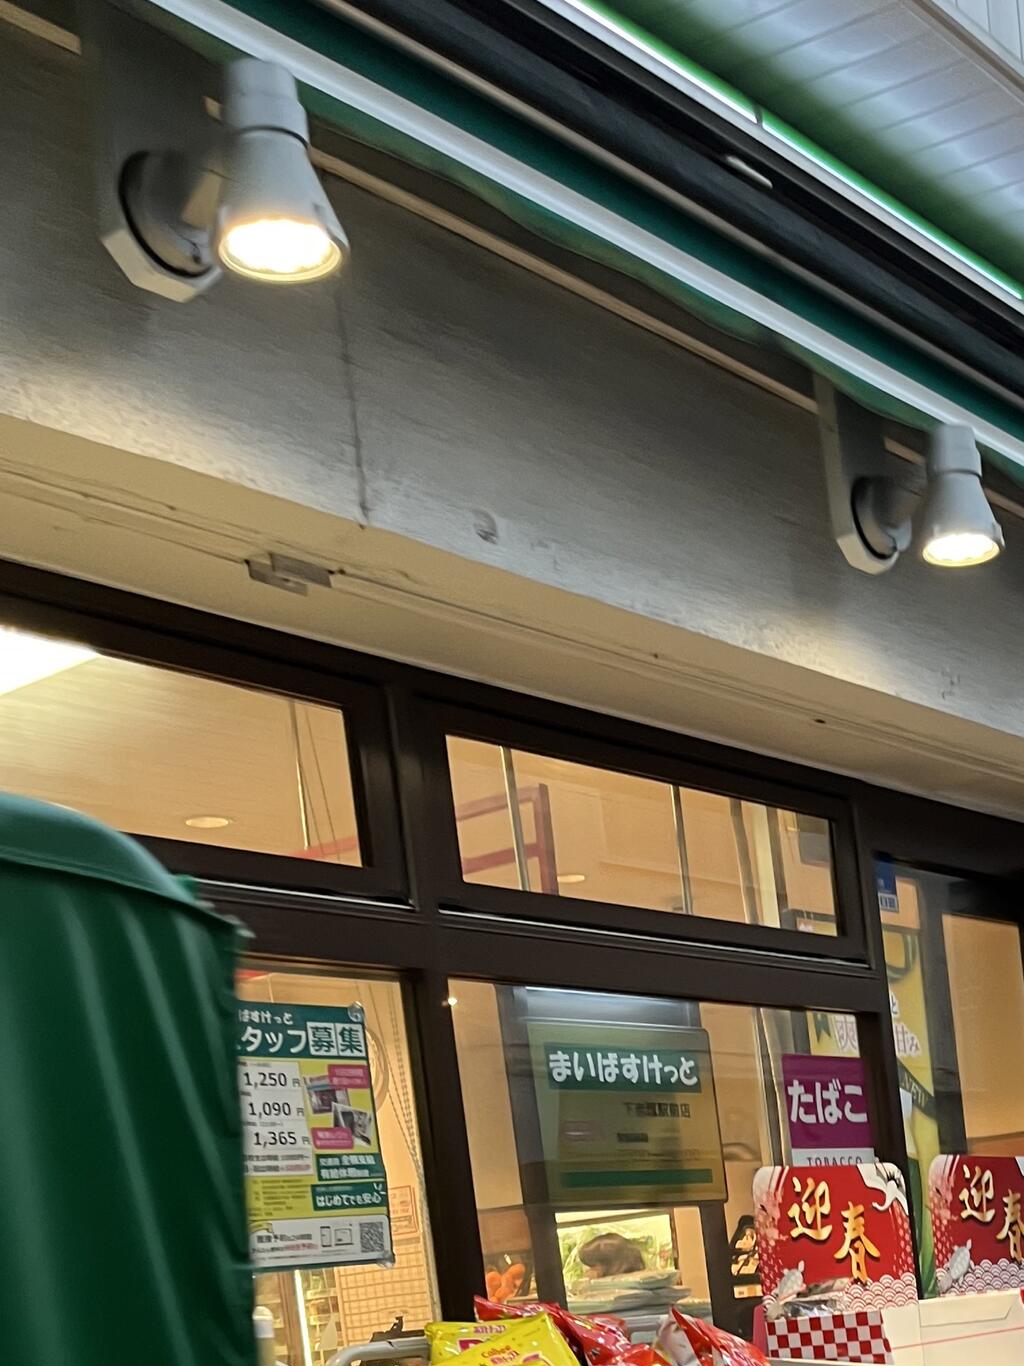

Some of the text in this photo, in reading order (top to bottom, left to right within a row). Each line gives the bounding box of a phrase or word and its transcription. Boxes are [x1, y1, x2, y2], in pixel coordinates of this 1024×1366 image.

[237, 1025, 364, 1054] タッフ募集
[549, 1051, 698, 1086] まいばすけっと
[787, 1078, 868, 1123] たばこ
[253, 1131, 298, 1147] 1,365
